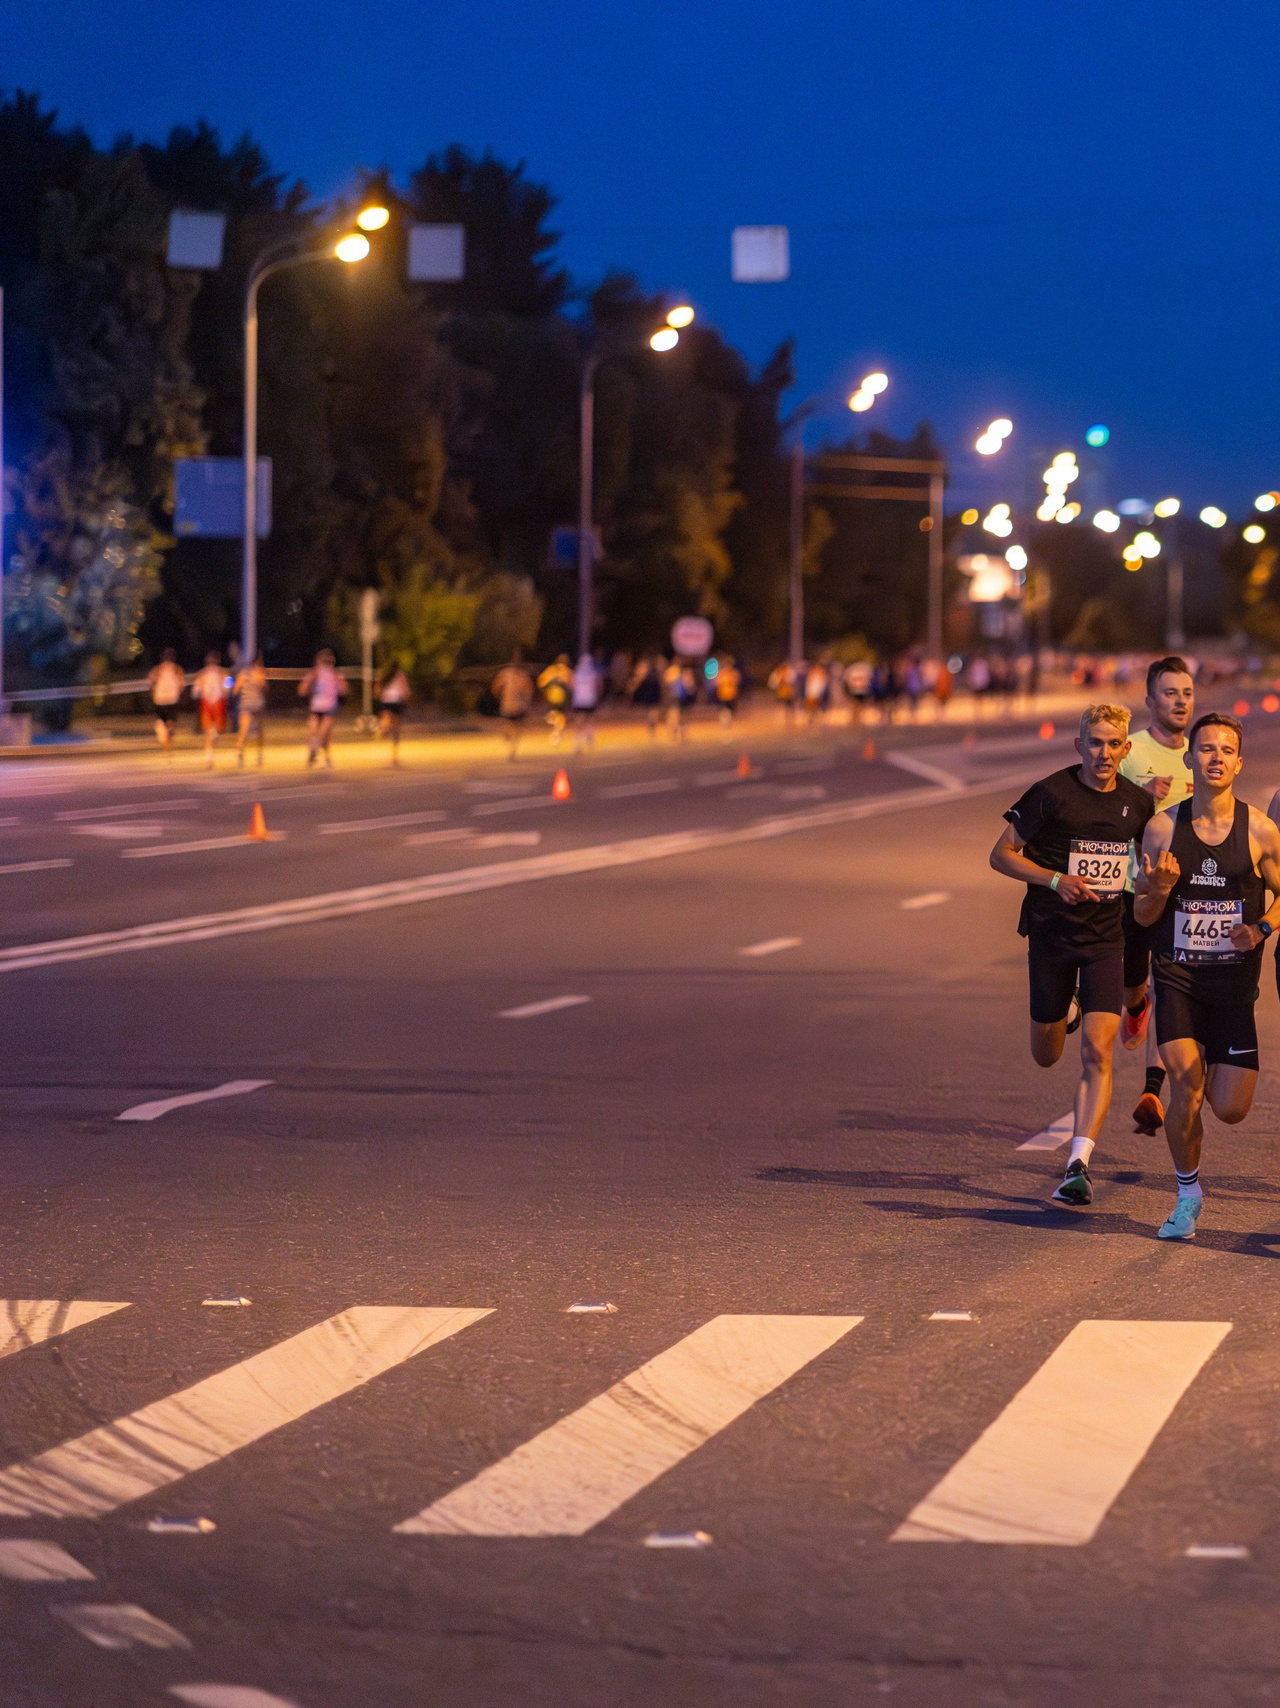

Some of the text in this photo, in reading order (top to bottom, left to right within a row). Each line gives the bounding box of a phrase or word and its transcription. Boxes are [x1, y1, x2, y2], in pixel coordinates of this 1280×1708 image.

[1078, 840, 1128, 853] НОЧНОЙ
[1077, 859, 1121, 879] 8326
[1182, 900, 1237, 912] НОЧНОЙ
[1181, 919, 1232, 939] 4465
